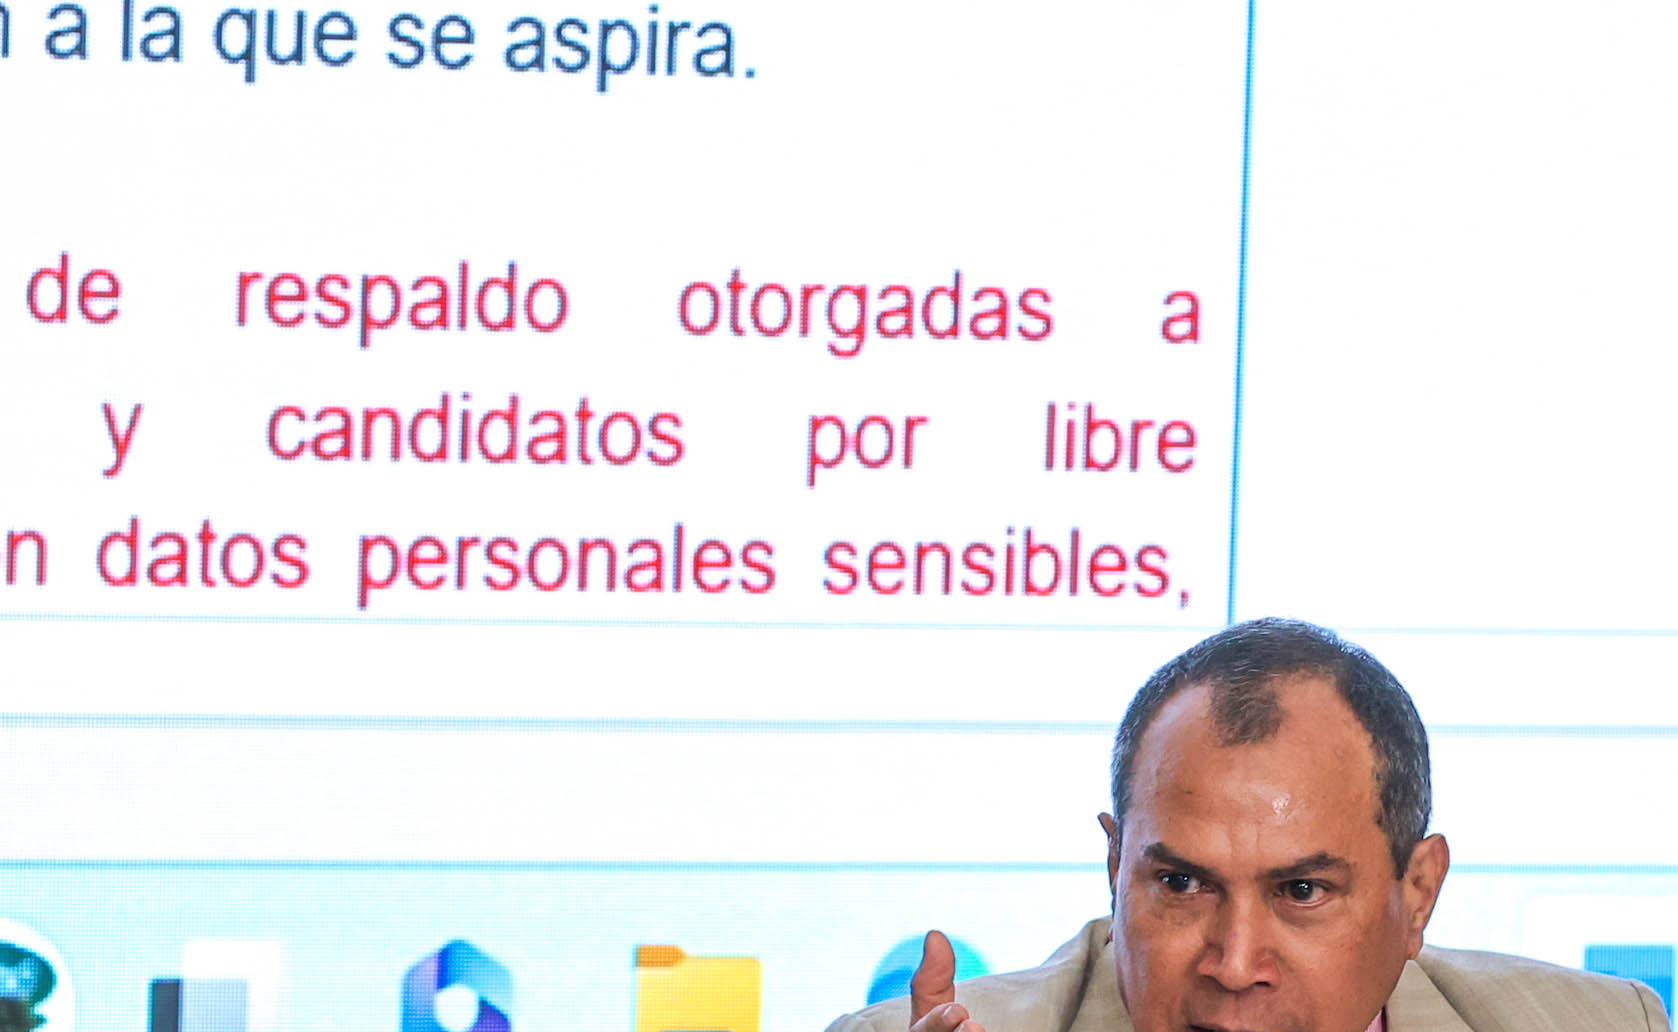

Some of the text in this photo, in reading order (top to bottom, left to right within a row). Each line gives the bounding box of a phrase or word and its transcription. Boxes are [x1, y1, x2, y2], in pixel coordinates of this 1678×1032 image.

[45, 3, 88, 60] a
[122, 0, 183, 62] la
[212, 6, 358, 84] que
[387, 13, 475, 70] se
[504, 4, 756, 93] aspira.
[26, 252, 1200, 358] de respaldo otorgadas a
[103, 392, 1197, 487] y candidatos por libre
[96, 517, 310, 589] datos
[357, 523, 776, 610] personales
[823, 527, 1189, 608] sensibles,
